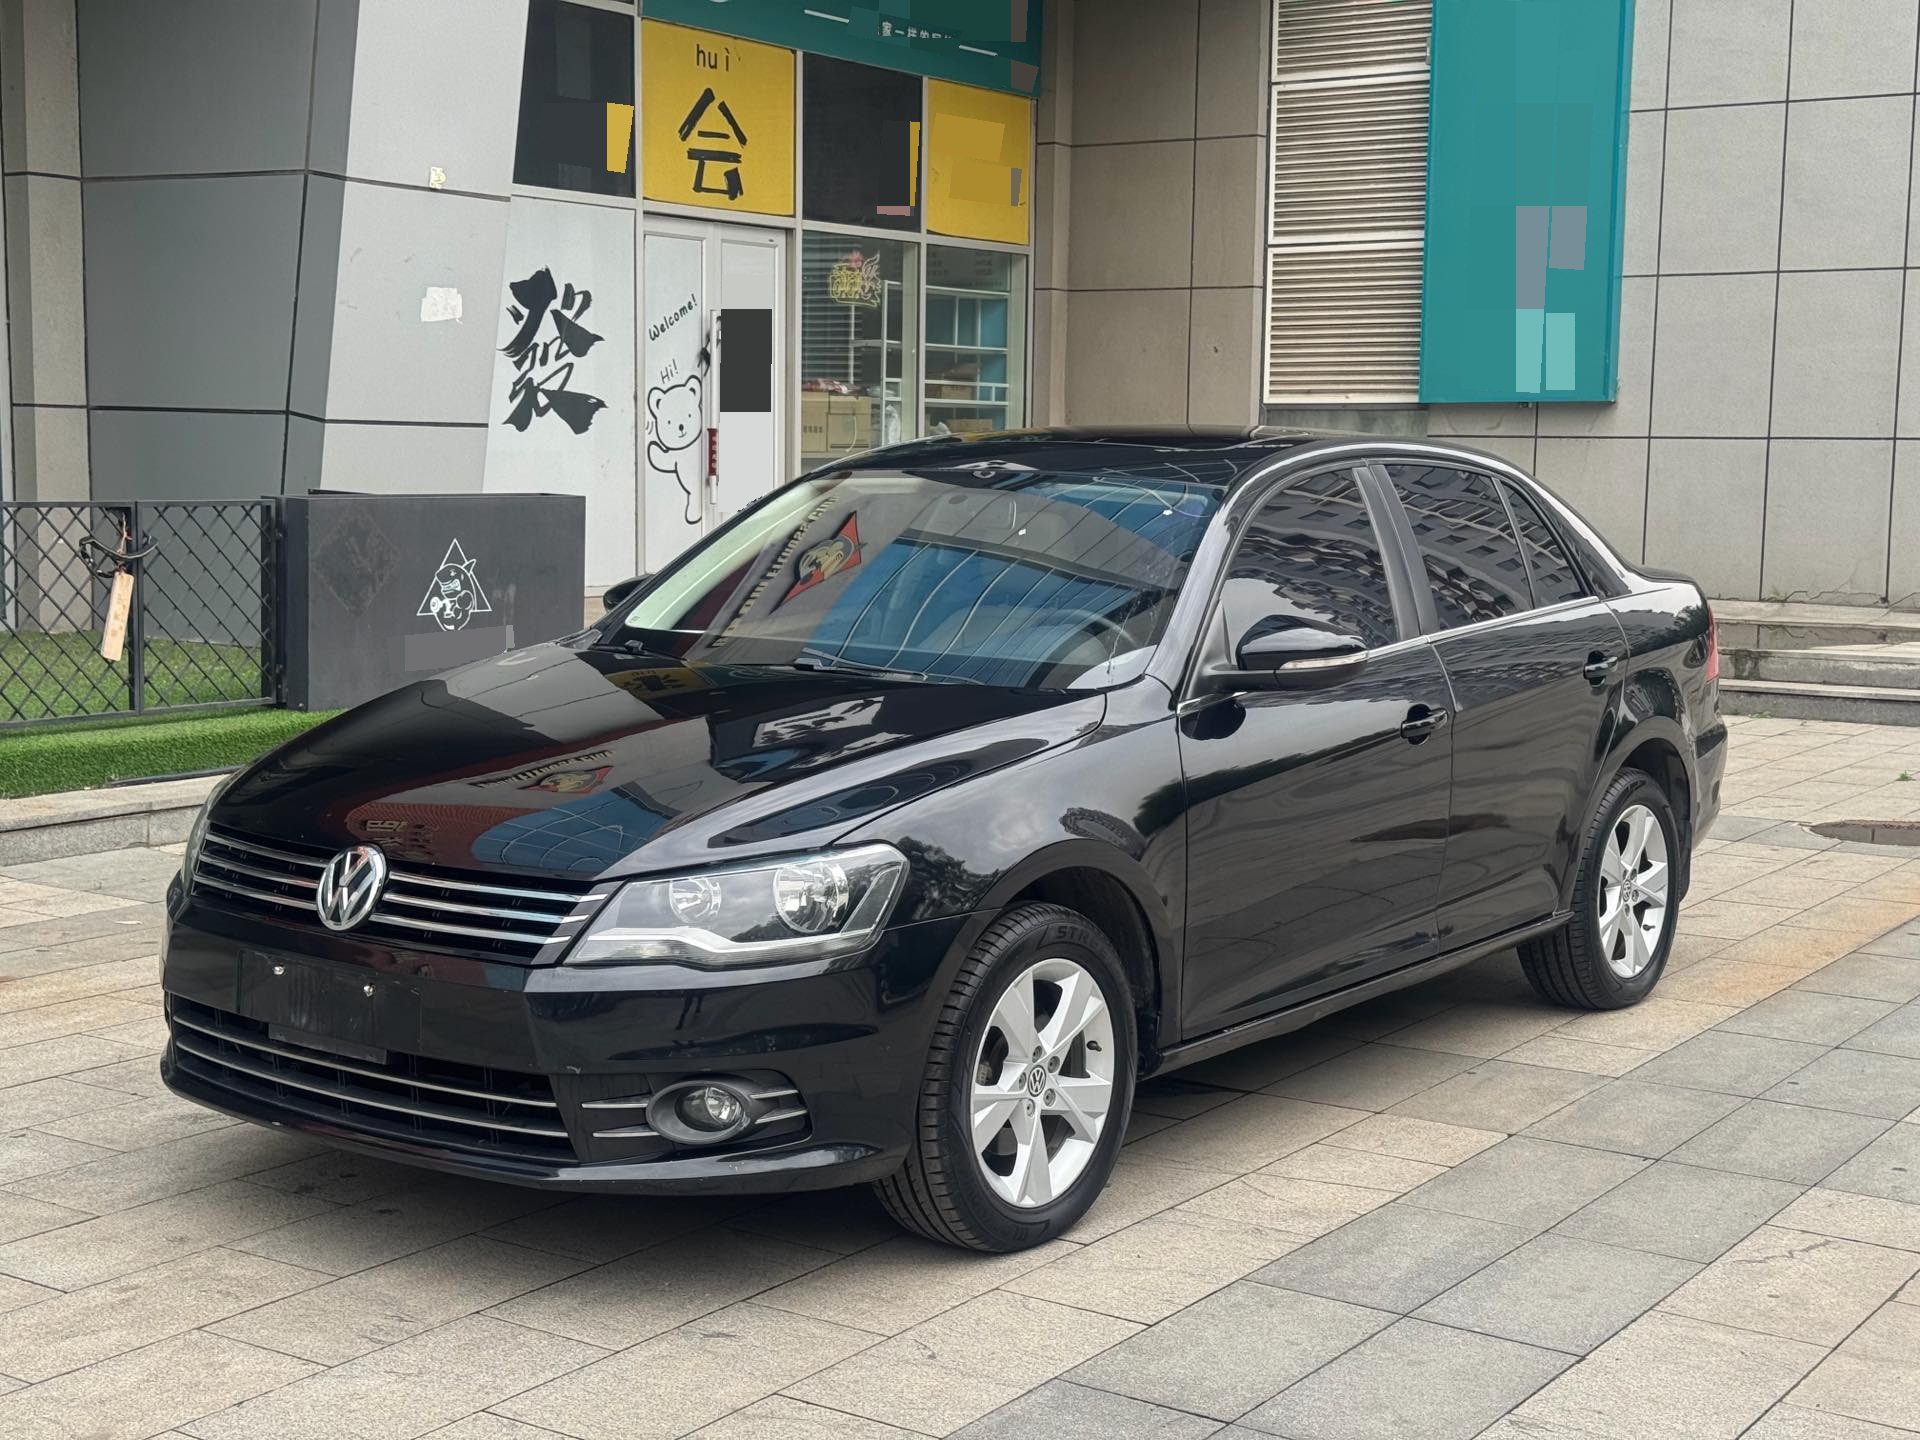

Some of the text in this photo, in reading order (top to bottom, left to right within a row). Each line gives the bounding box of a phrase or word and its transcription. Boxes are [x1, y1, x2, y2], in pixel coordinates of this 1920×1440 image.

[678, 87, 748, 201] 会
[648, 293, 698, 341] Welcome!
[660, 358, 679, 385] Hi!
